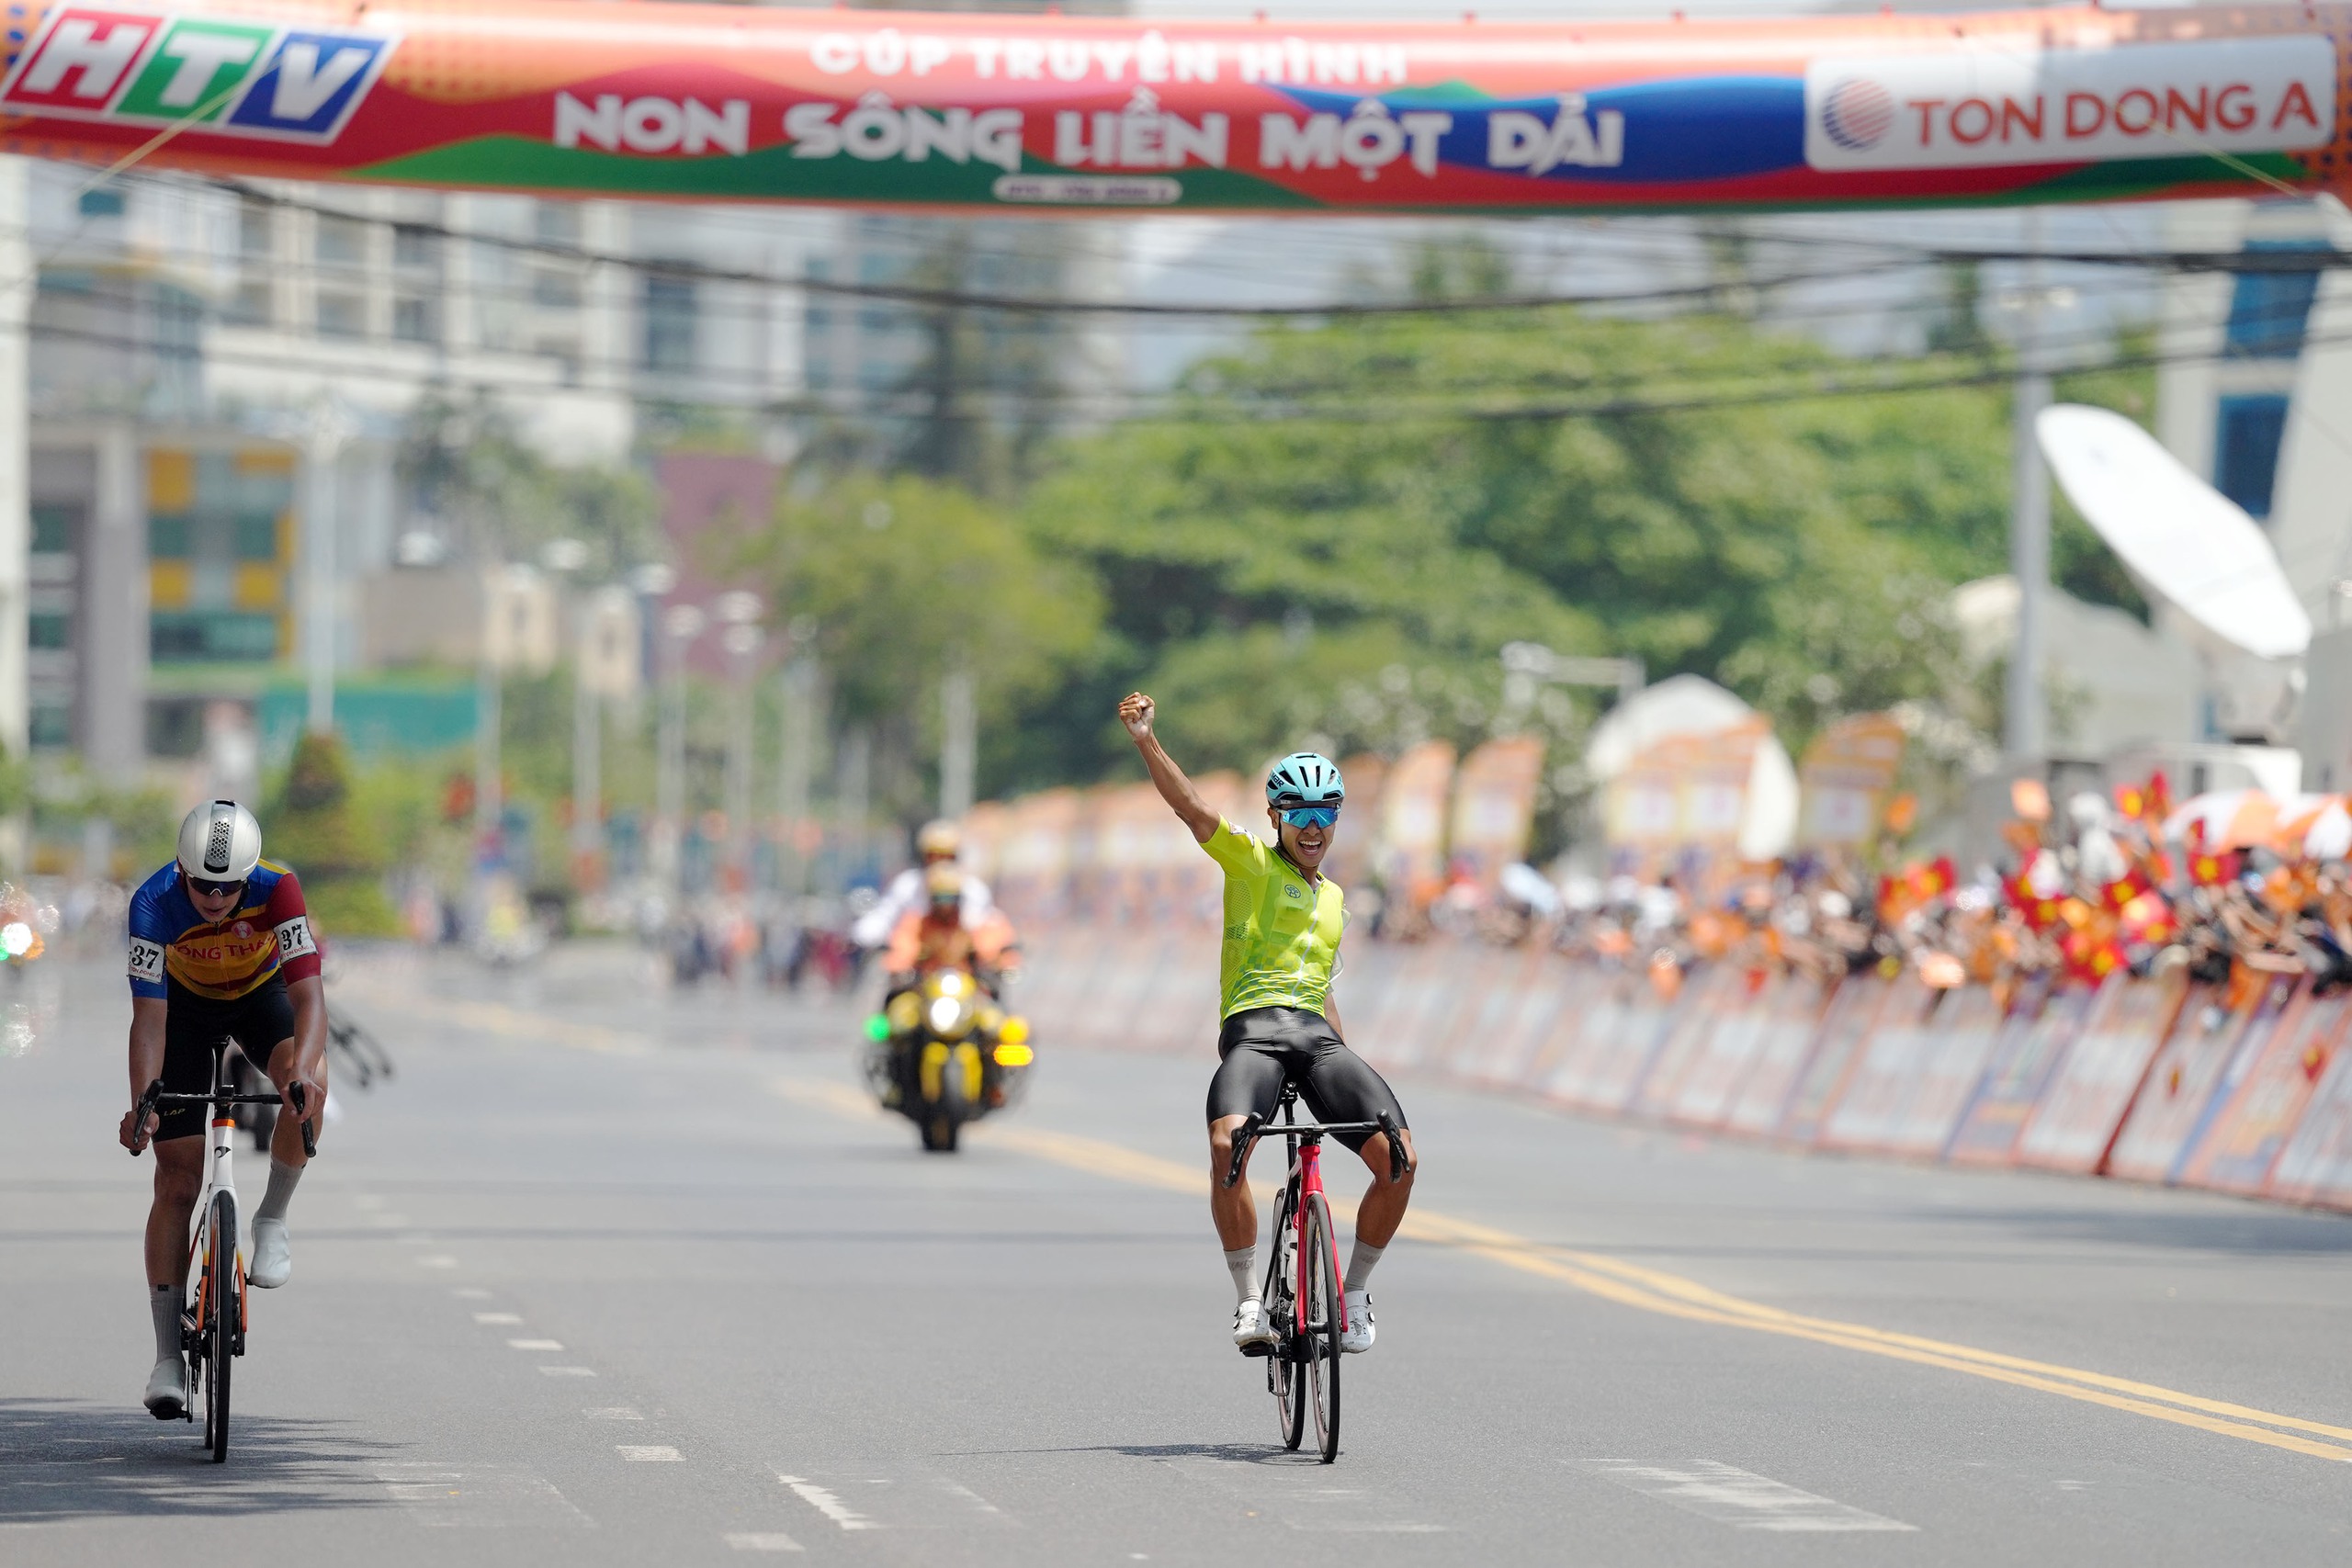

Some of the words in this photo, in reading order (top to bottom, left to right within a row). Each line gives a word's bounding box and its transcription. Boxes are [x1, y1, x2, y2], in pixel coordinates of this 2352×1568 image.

[22, 17, 372, 122] HTV
[553, 92, 751, 155] NON
[784, 90, 1023, 173] SÔNG
[1261, 96, 1453, 181] MỘT
[1907, 95, 2045, 147] TON
[2064, 84, 2257, 140] DONG
[2272, 82, 2320, 130] A
[131, 944, 160, 970] 37
[281, 923, 302, 951] 37
